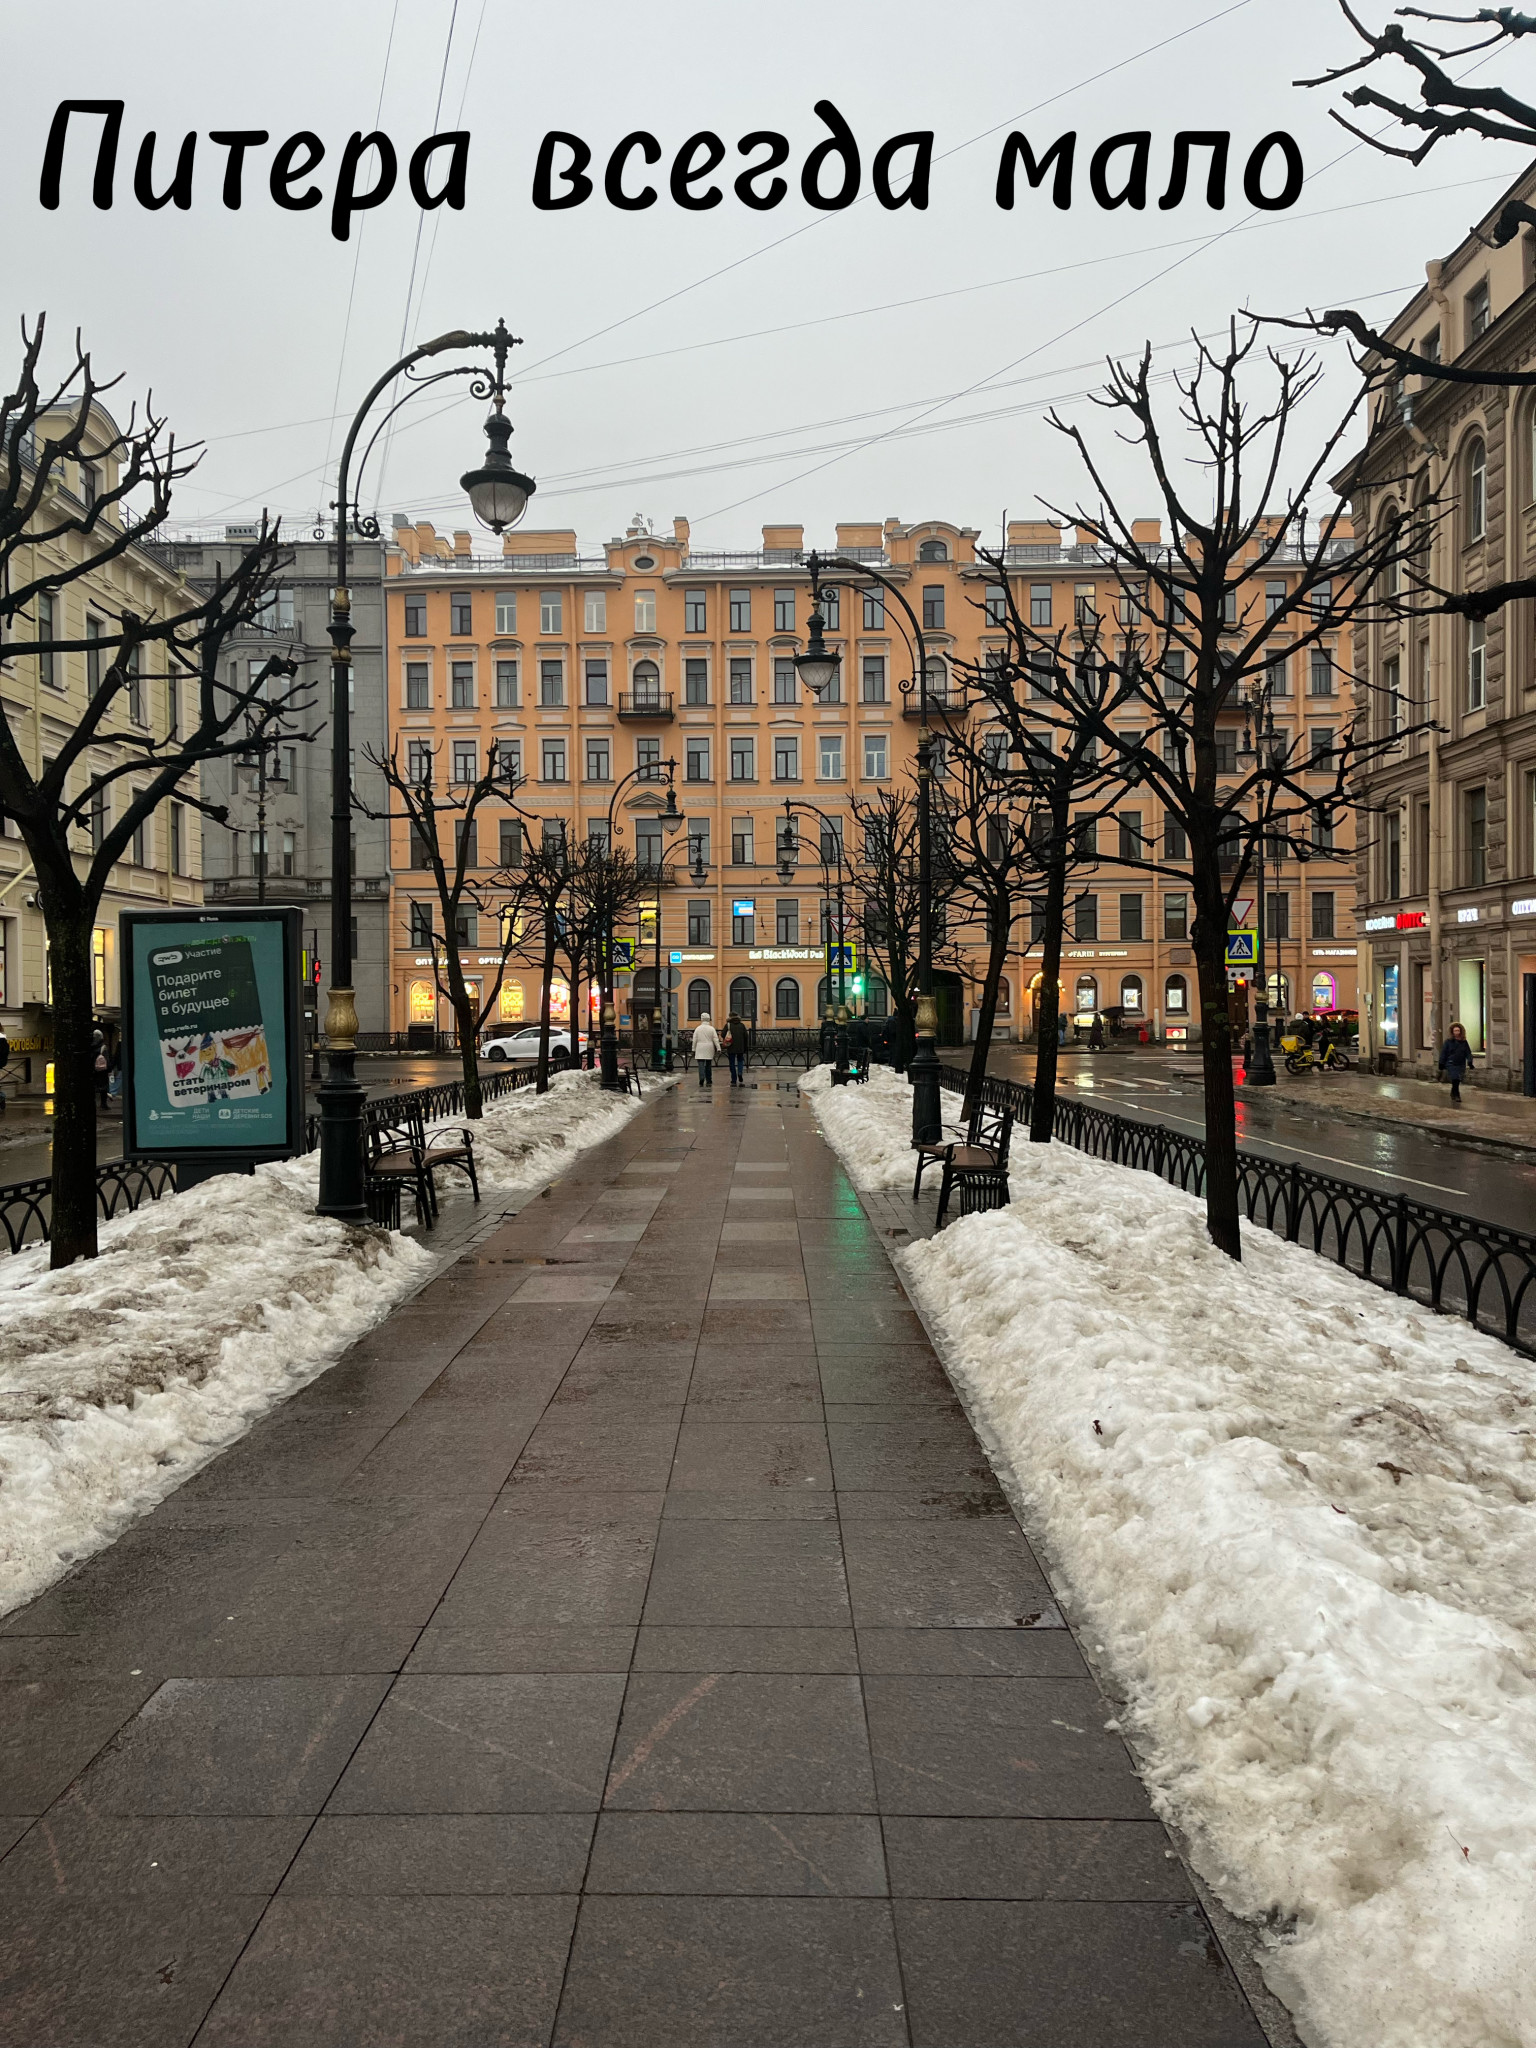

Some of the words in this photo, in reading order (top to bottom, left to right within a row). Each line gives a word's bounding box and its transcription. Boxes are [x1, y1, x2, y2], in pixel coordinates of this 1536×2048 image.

[184, 947, 222, 959] Участие
[763, 950, 807, 959] BlackWood
[810, 951, 824, 959] Pub
[415, 958, 448, 966] ОПТКА
[478, 957, 508, 965] OPTIC
[156, 969, 222, 987] Подарите
[158, 988, 197, 1001] билет
[161, 1006, 169, 1015] в
[171, 997, 230, 1016] будущее
[172, 1077, 205, 1087] стать
[174, 1078, 251, 1097] ветеринаром
